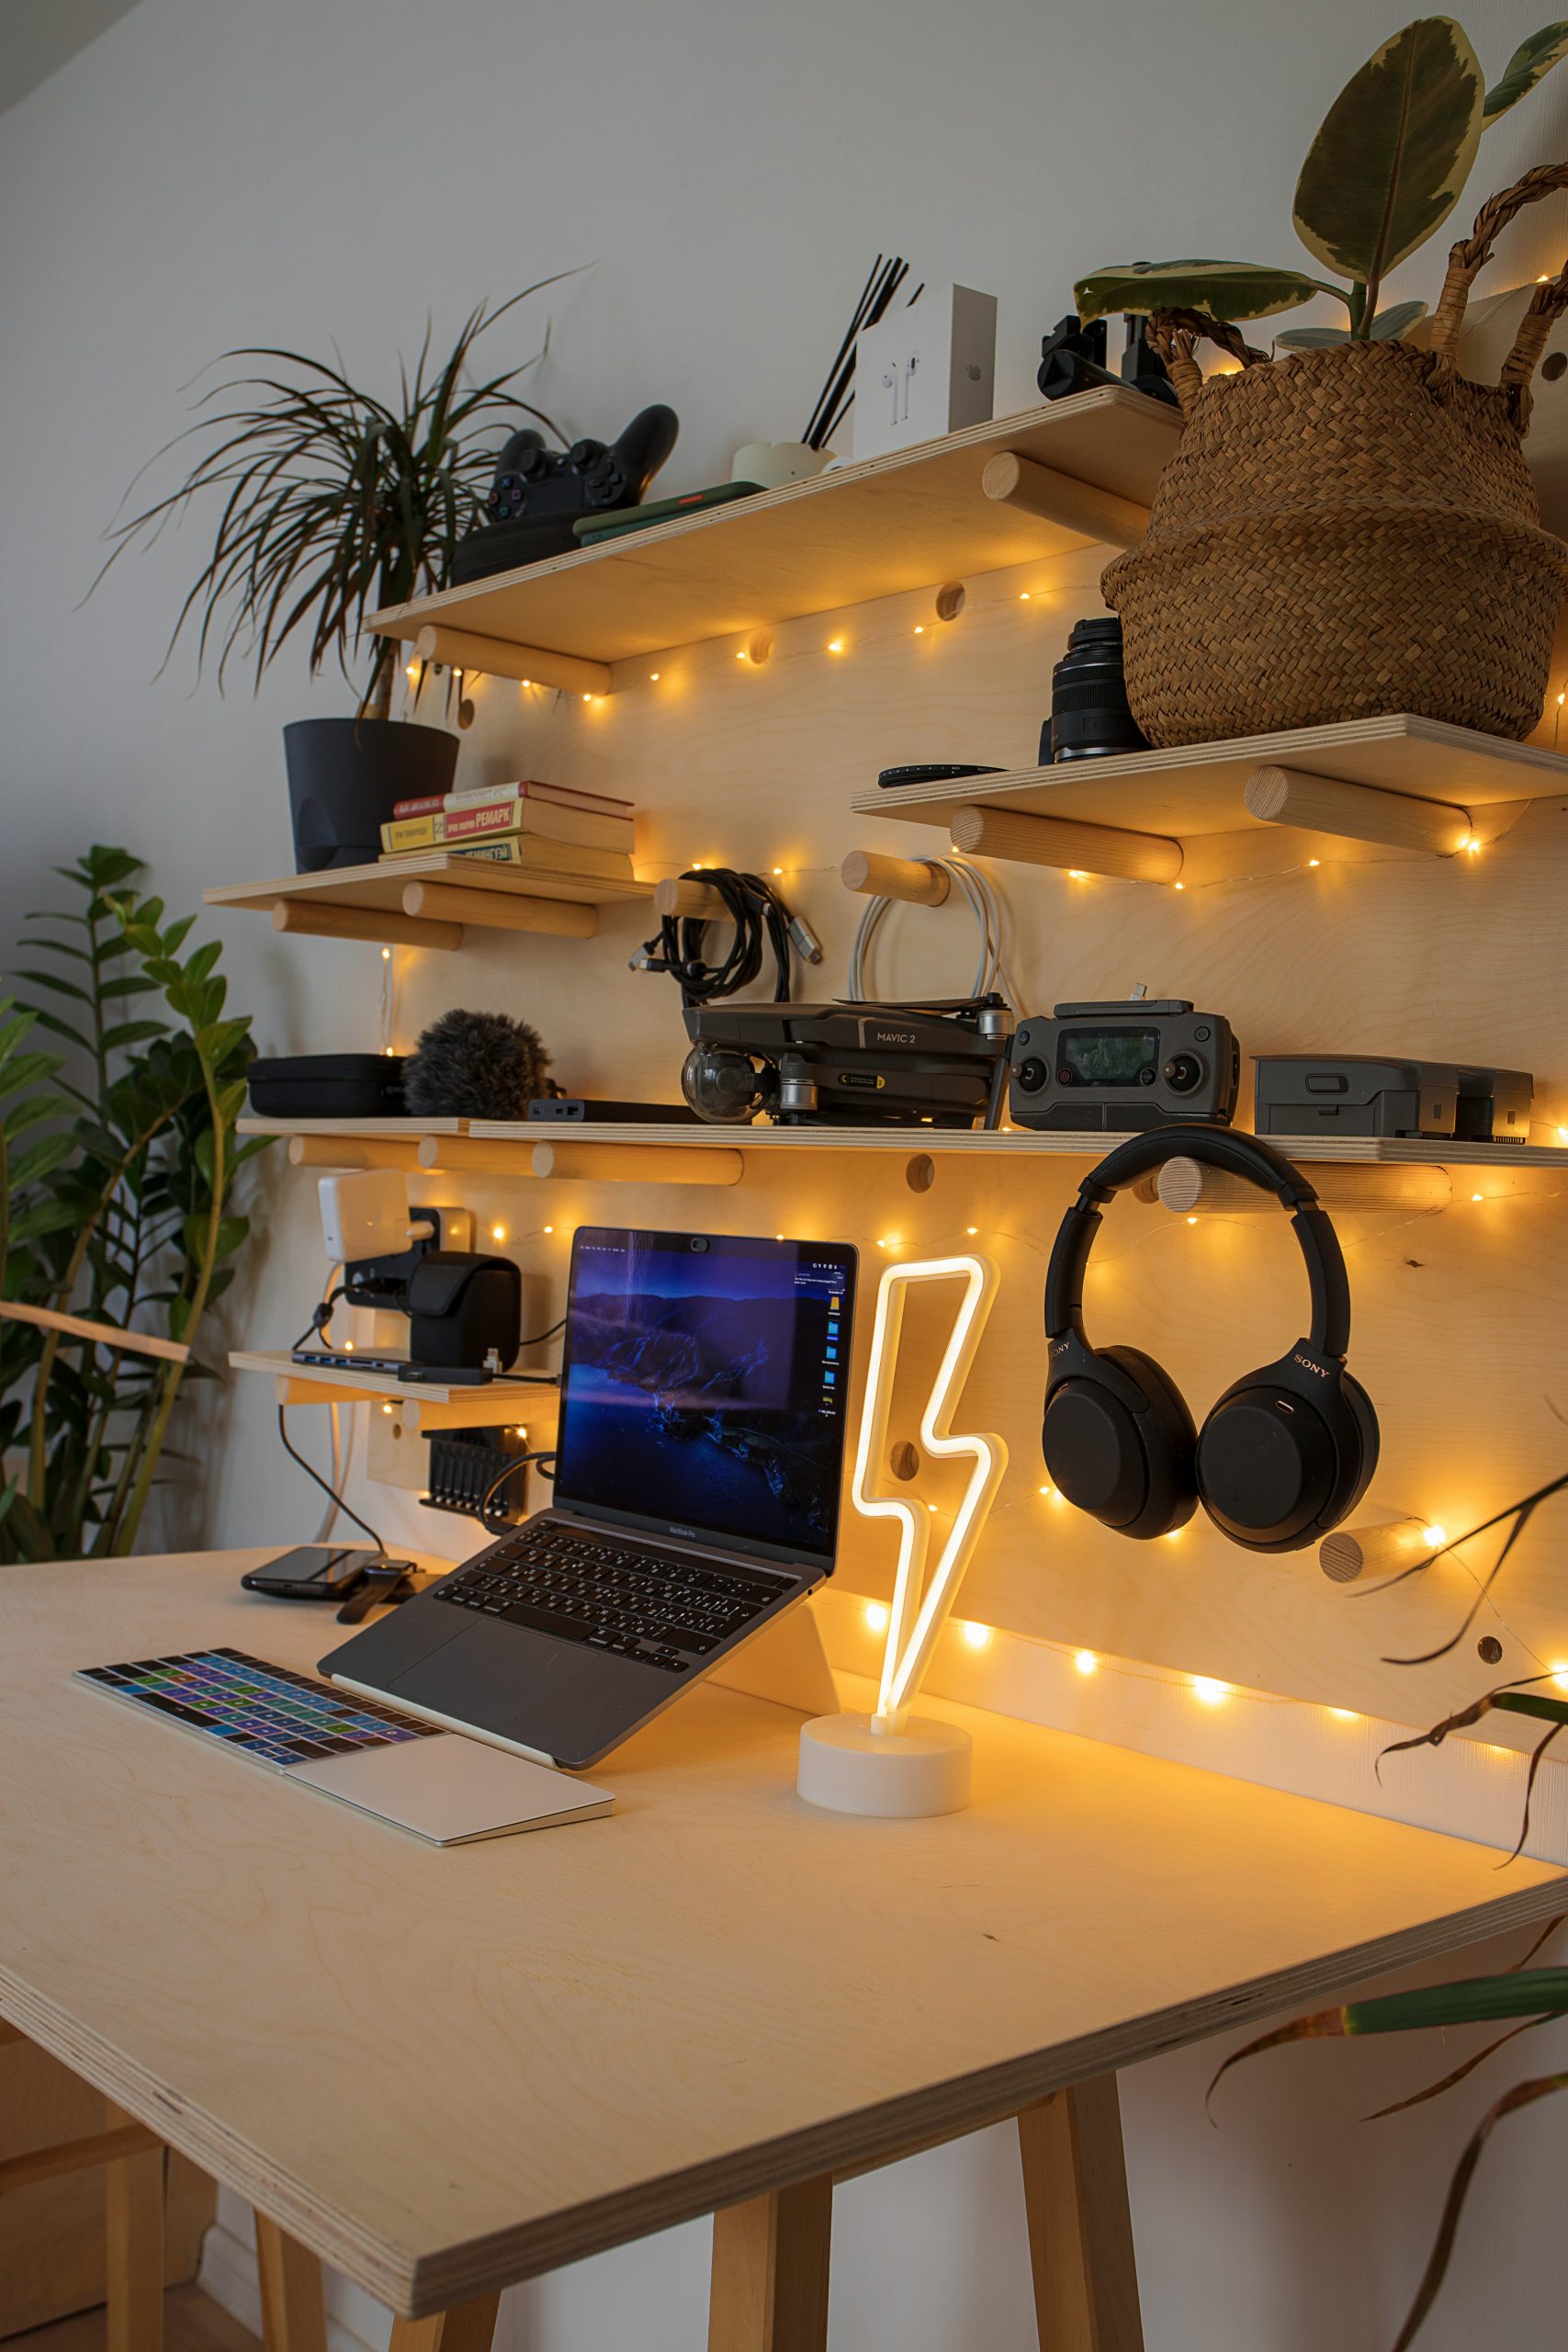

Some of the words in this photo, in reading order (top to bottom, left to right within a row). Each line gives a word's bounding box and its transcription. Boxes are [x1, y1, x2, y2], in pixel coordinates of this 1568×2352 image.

[475, 806, 511, 828] РЕМАРК
[876, 1031, 908, 1044] MAVIC
[909, 1035, 917, 1044] 2
[1050, 1341, 1070, 1361] SONY
[1293, 1353, 1331, 1378] SONY
